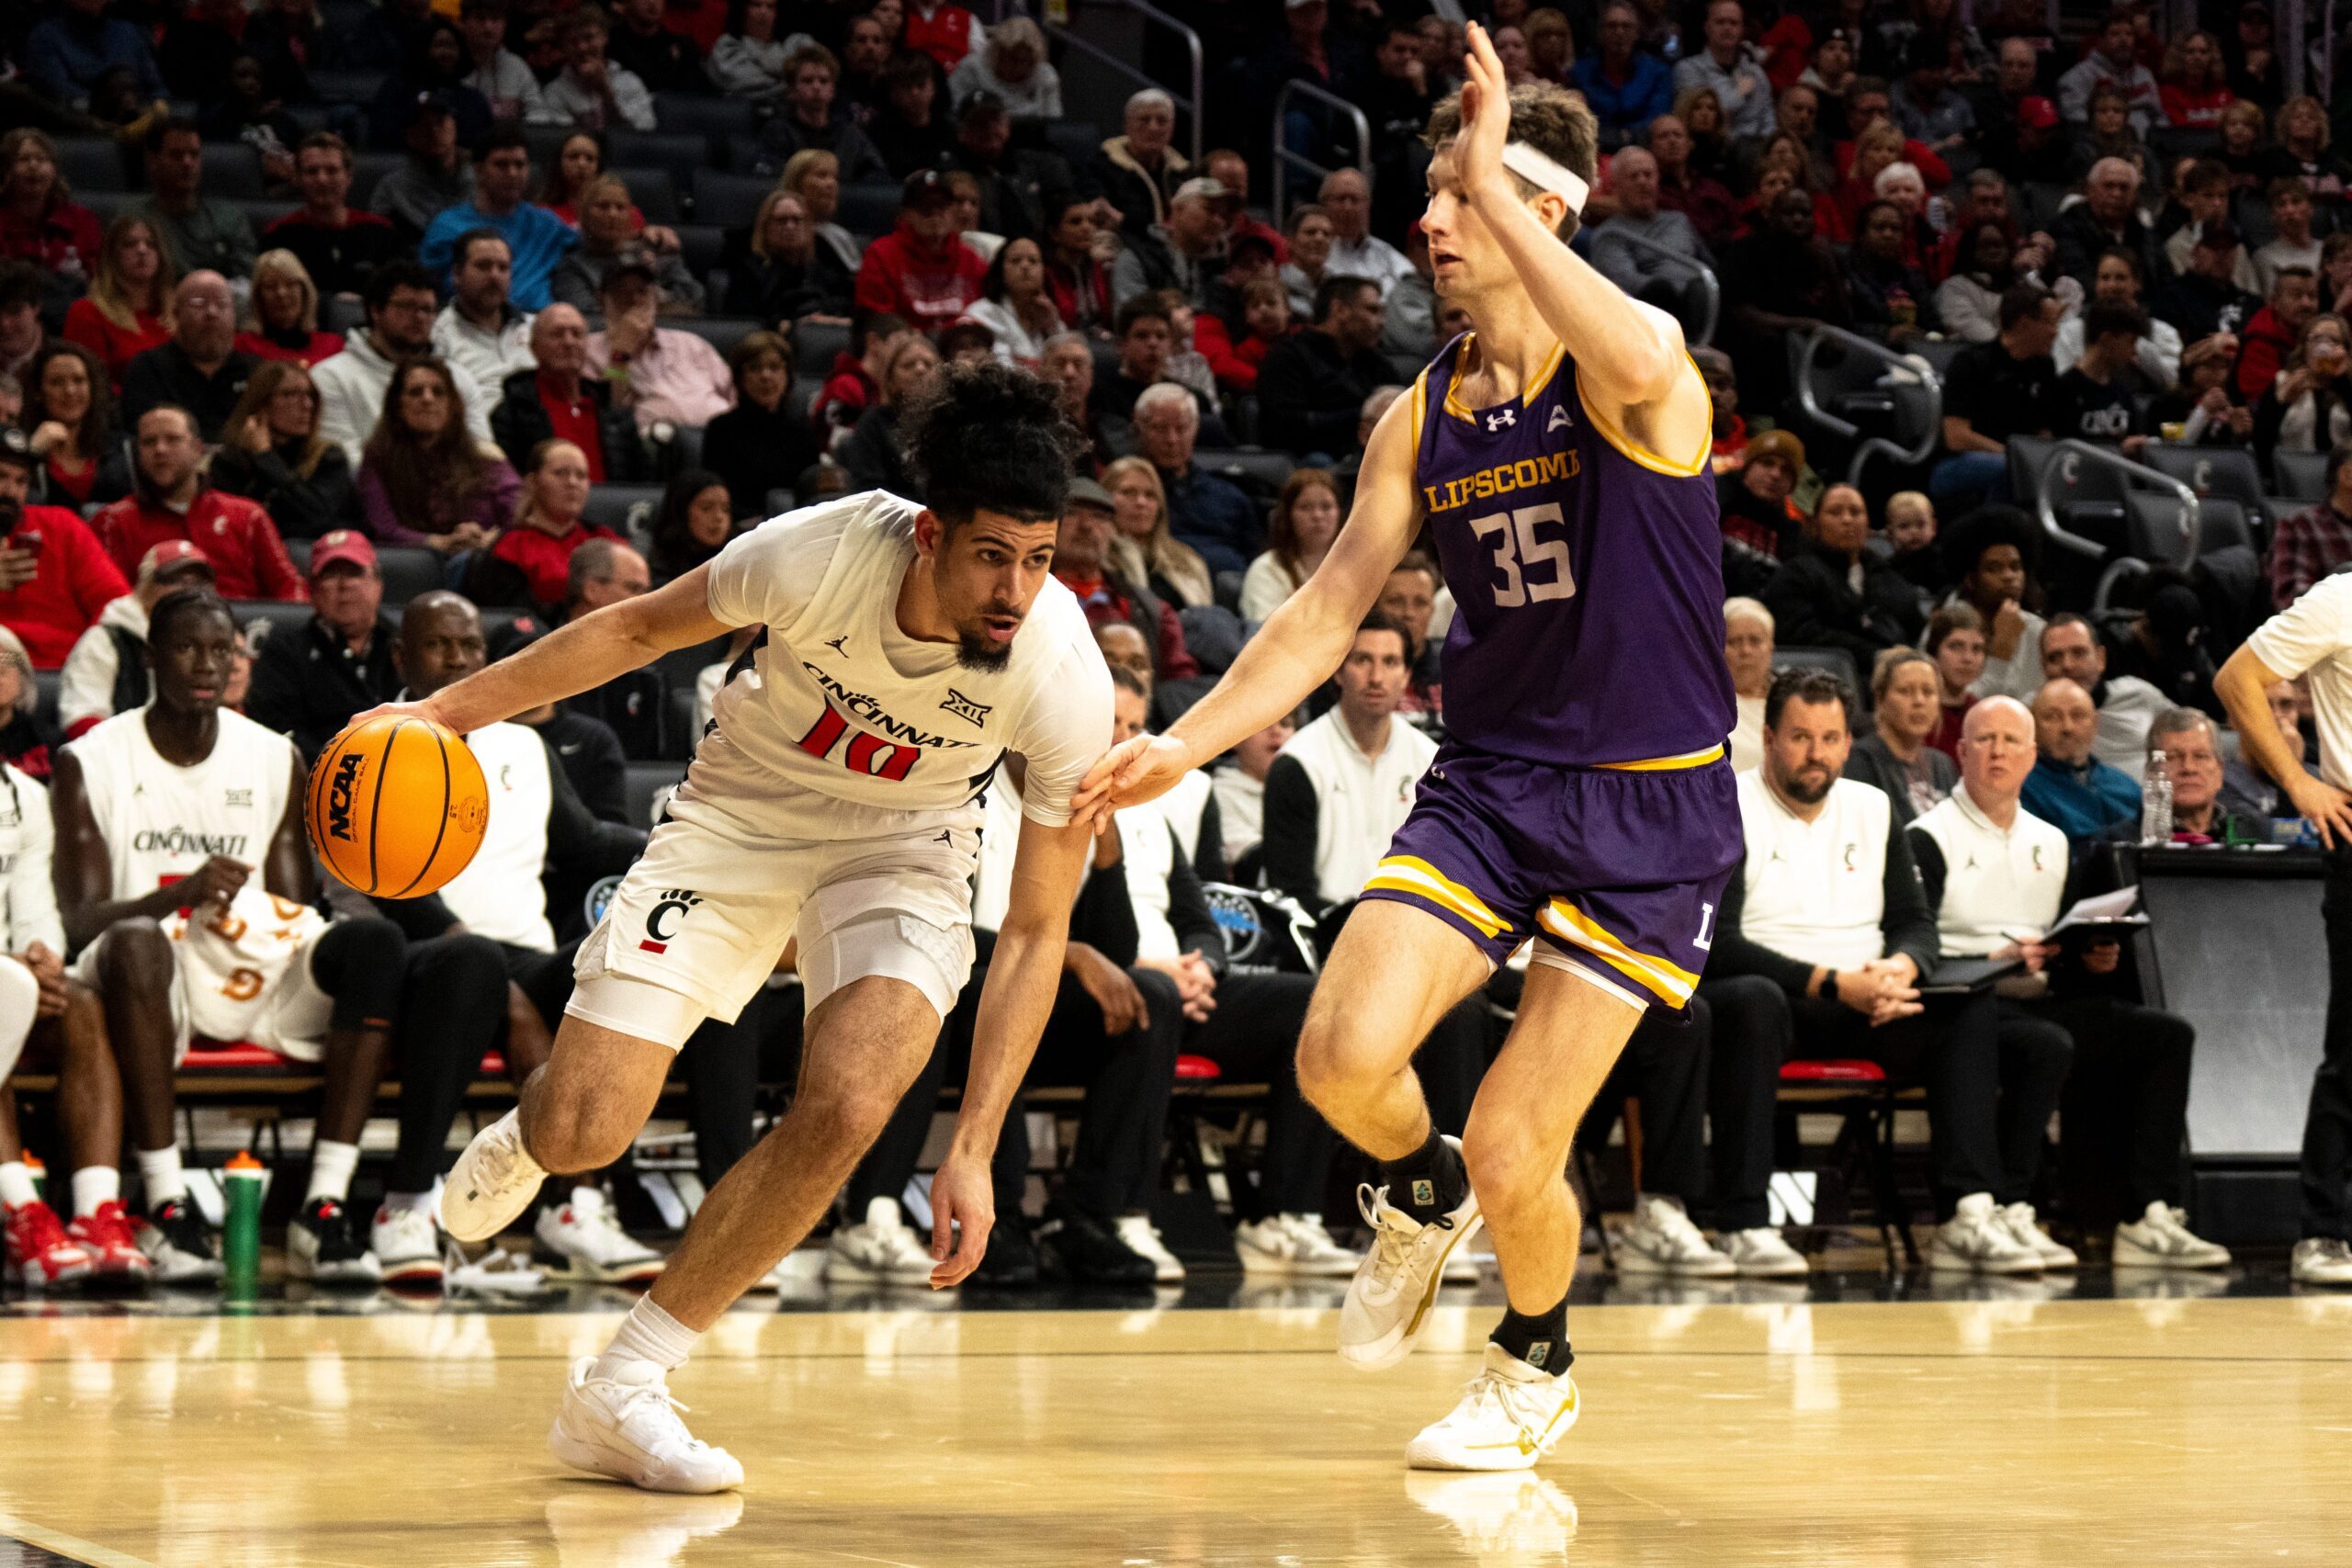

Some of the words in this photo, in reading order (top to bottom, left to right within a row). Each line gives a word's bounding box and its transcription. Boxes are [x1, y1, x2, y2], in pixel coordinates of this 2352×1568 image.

[1424, 448, 1581, 513] LIPSCOMB
[1468, 502, 1577, 608] 35
[939, 688, 993, 728] XII
[792, 693, 922, 782] 10
[329, 754, 365, 841] NCAA
[353, 778, 362, 804] GAME
[133, 827, 247, 855] CINCINNATI
[646, 888, 704, 942] C
[1692, 902, 1713, 952] L
